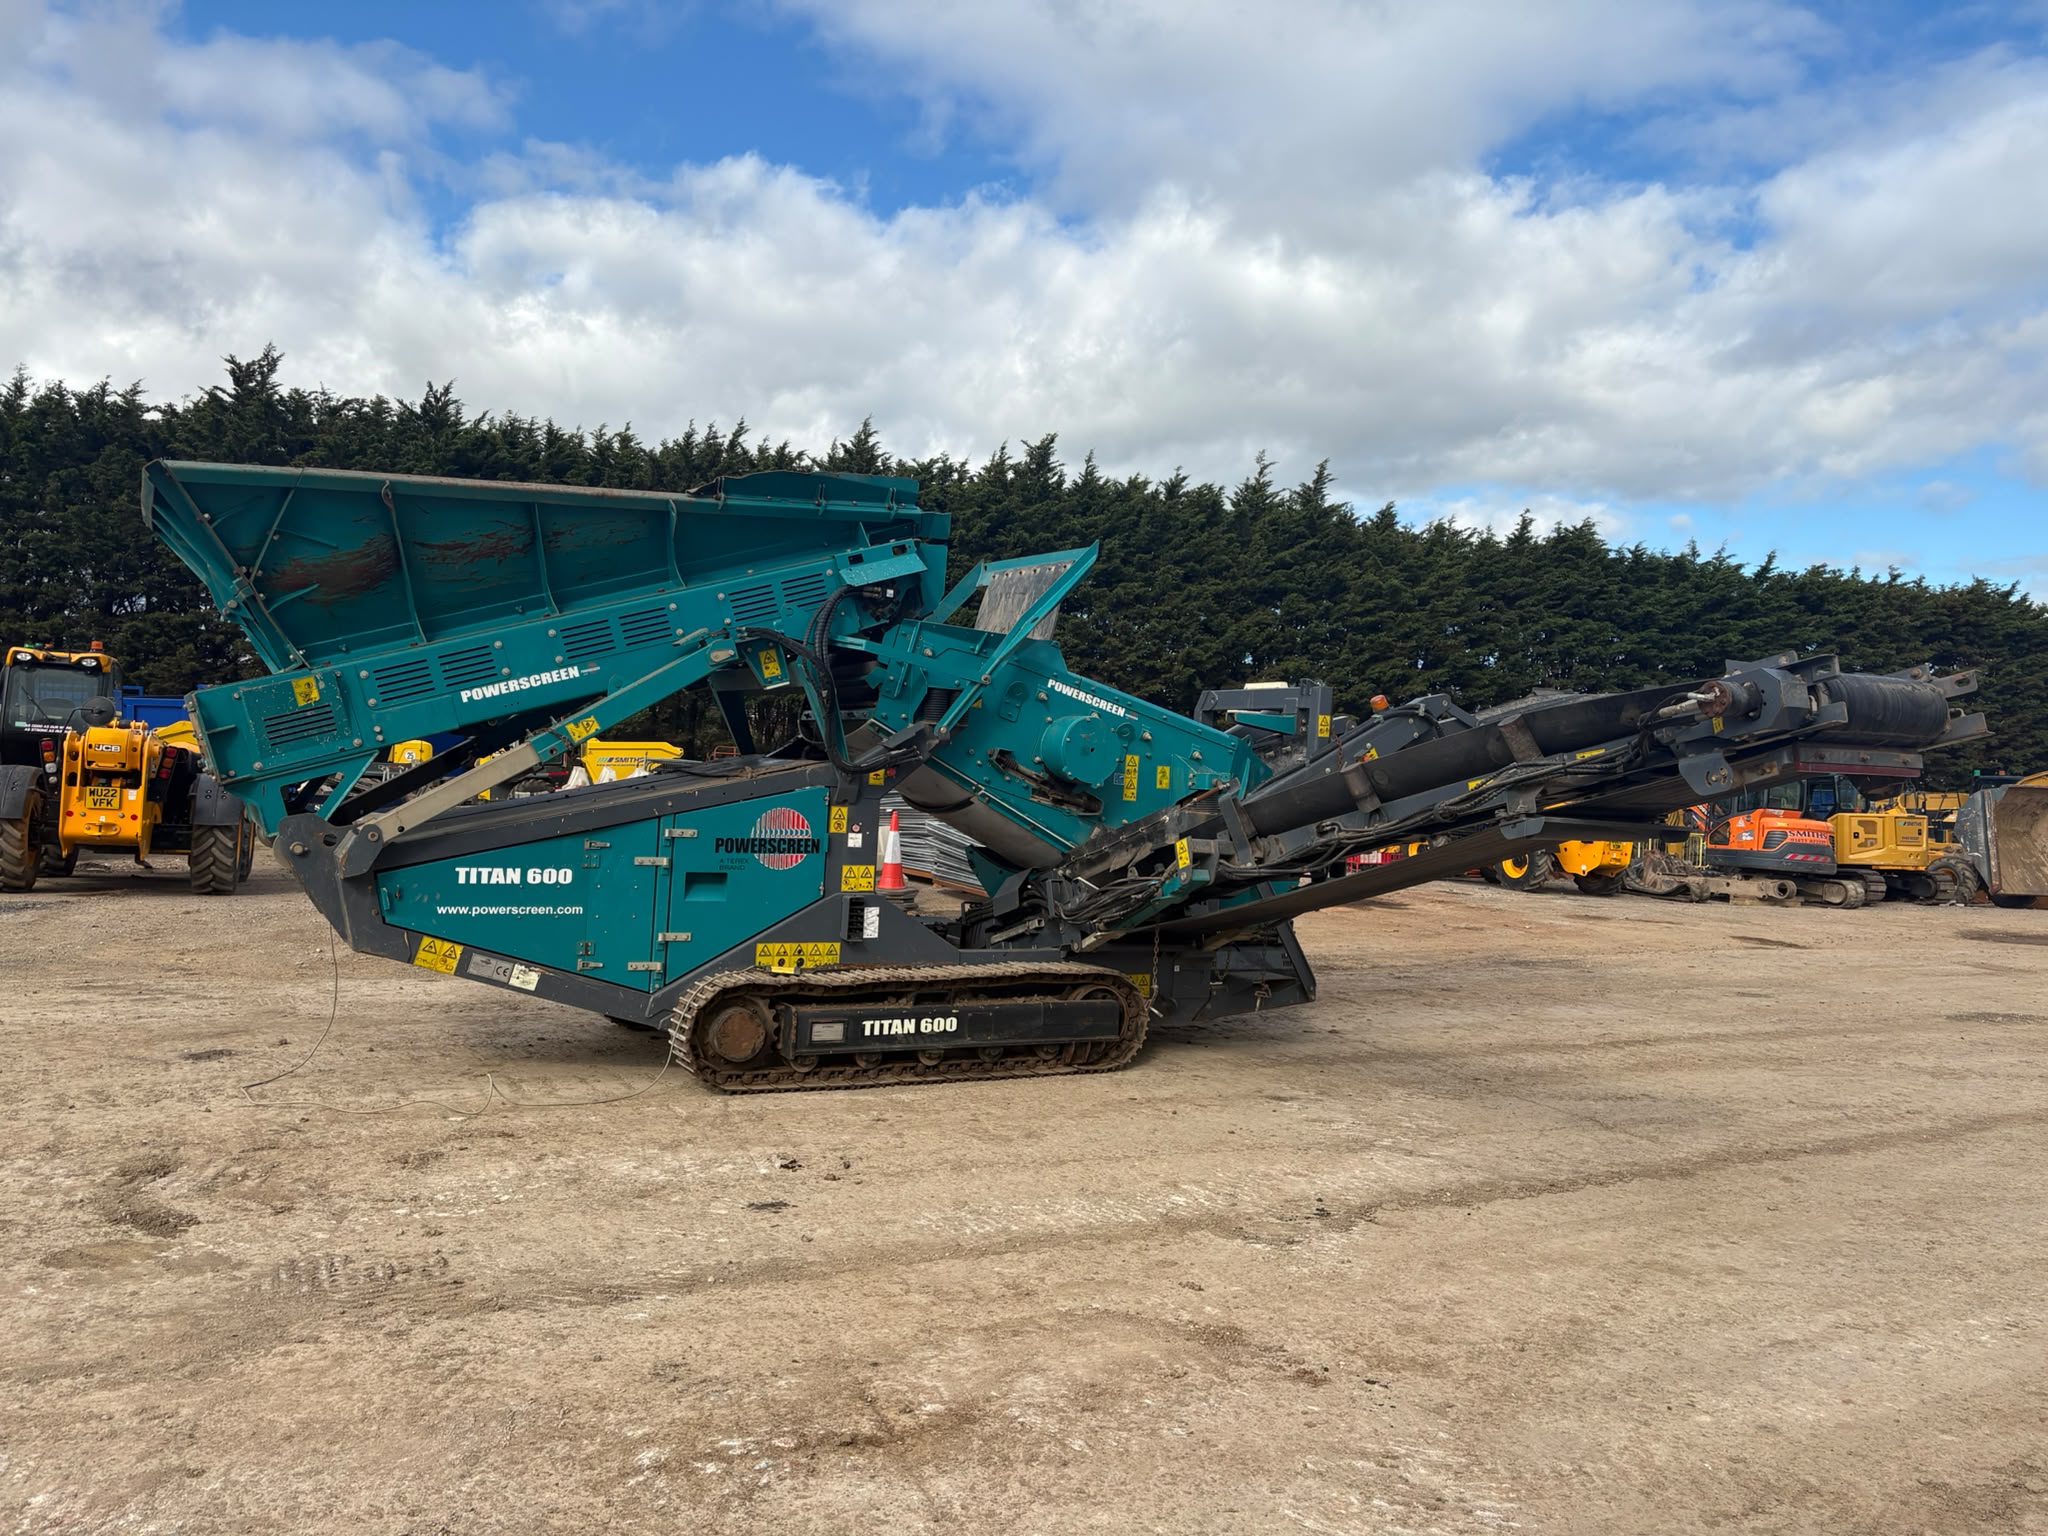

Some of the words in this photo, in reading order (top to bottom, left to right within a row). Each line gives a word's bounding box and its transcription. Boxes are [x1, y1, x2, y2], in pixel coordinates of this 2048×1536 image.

[460, 665, 580, 703] POWERSCREEN
[1047, 678, 1126, 718] POWERSCREEN
[94, 744, 121, 752] JCB
[406, 751, 415, 760] 25
[88, 788, 118, 798] WU22
[92, 797, 114, 808] VFK
[1787, 830, 1828, 840] SMITHS
[714, 837, 821, 854] POWERSCREEN
[455, 867, 521, 884] TITAN
[526, 867, 573, 885] 600
[436, 905, 584, 917] www.powerscreen.com
[862, 1018, 916, 1037] TITAN
[920, 1017, 958, 1034] 600
